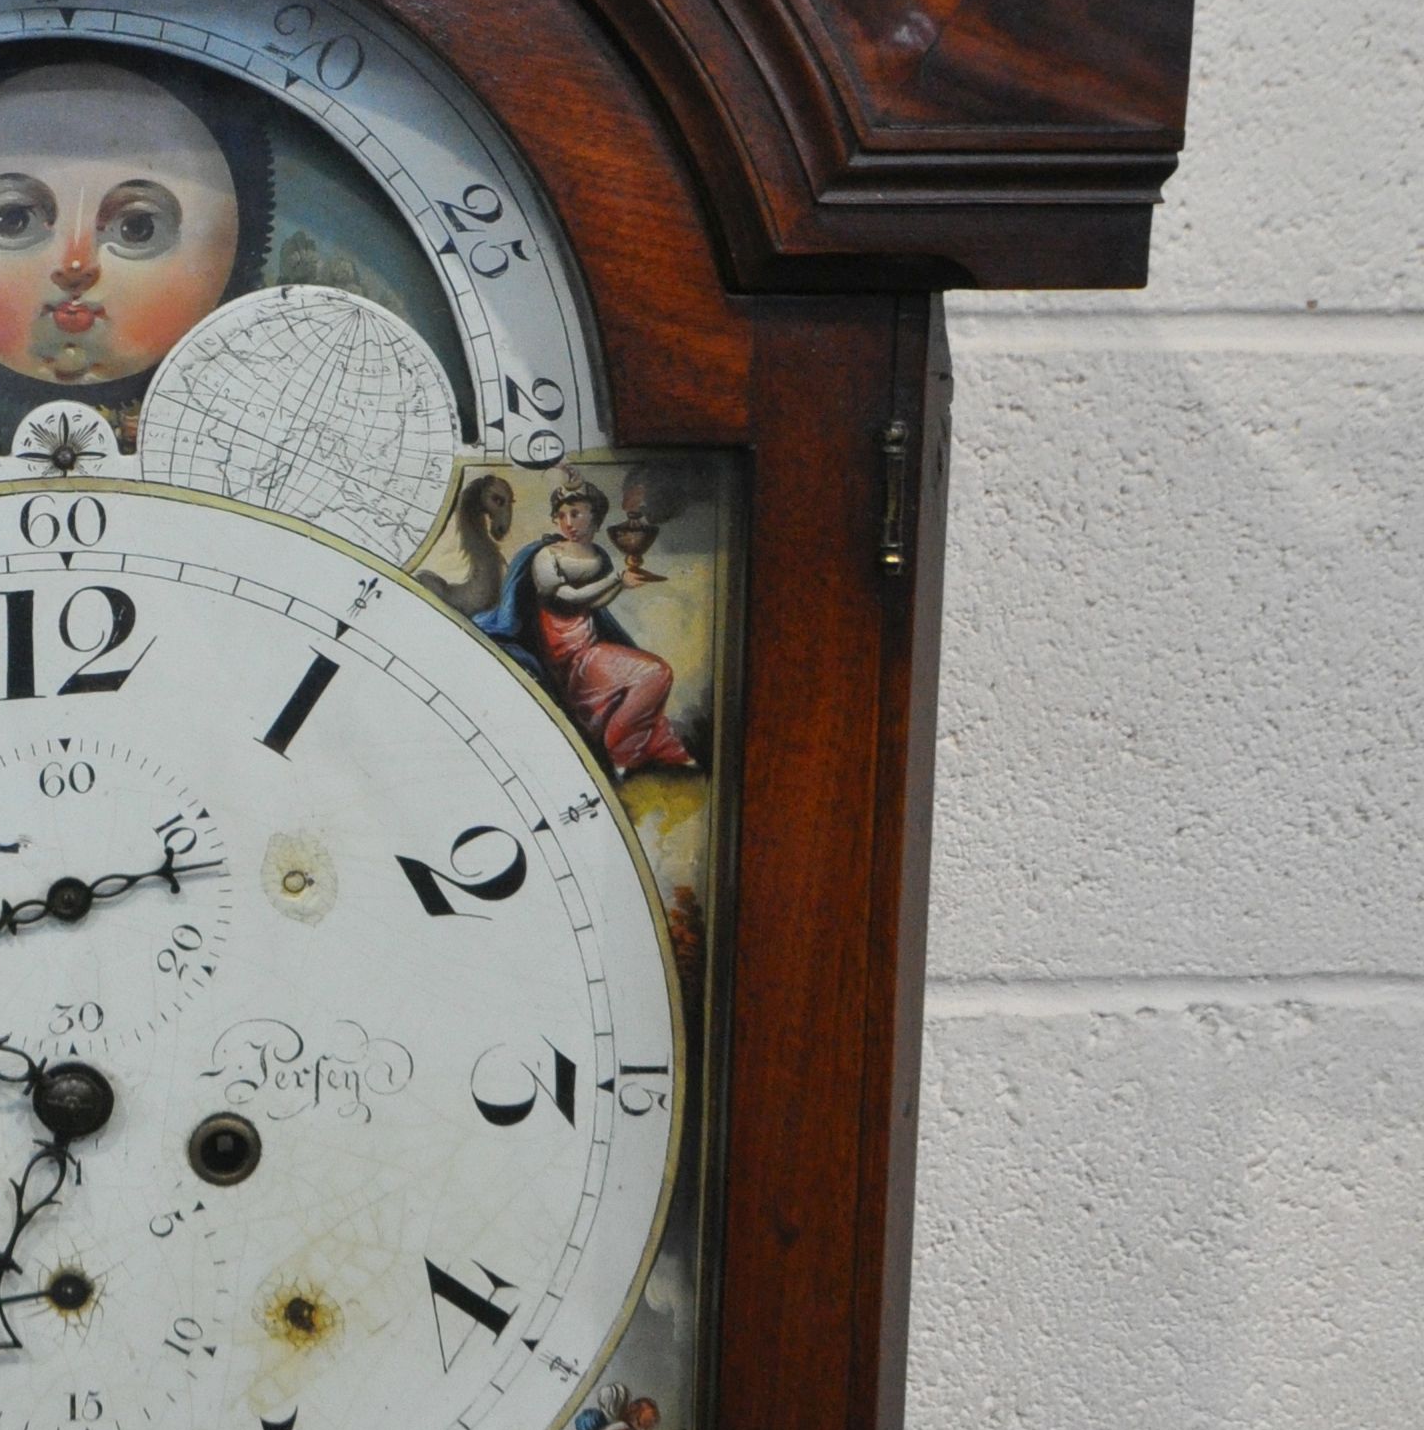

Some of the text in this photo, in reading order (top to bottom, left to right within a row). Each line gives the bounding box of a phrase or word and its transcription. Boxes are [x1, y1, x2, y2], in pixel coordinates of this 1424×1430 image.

[261, 3, 366, 91] 20
[434, 183, 531, 279] 25
[19, 493, 107, 549] 60
[252, 644, 341, 762] 1
[39, 761, 96, 798] 60
[152, 813, 198, 855] 10
[394, 824, 529, 920] 2
[156, 924, 203, 980] 20
[47, 1001, 105, 1035] 30
[470, 1033, 577, 1131] 3
[618, 1052, 670, 1116] 15
[149, 1210, 185, 1238] 5
[162, 1316, 204, 1357] 10
[423, 1255, 520, 1374] 4
[69, 1389, 103, 1422] 15
